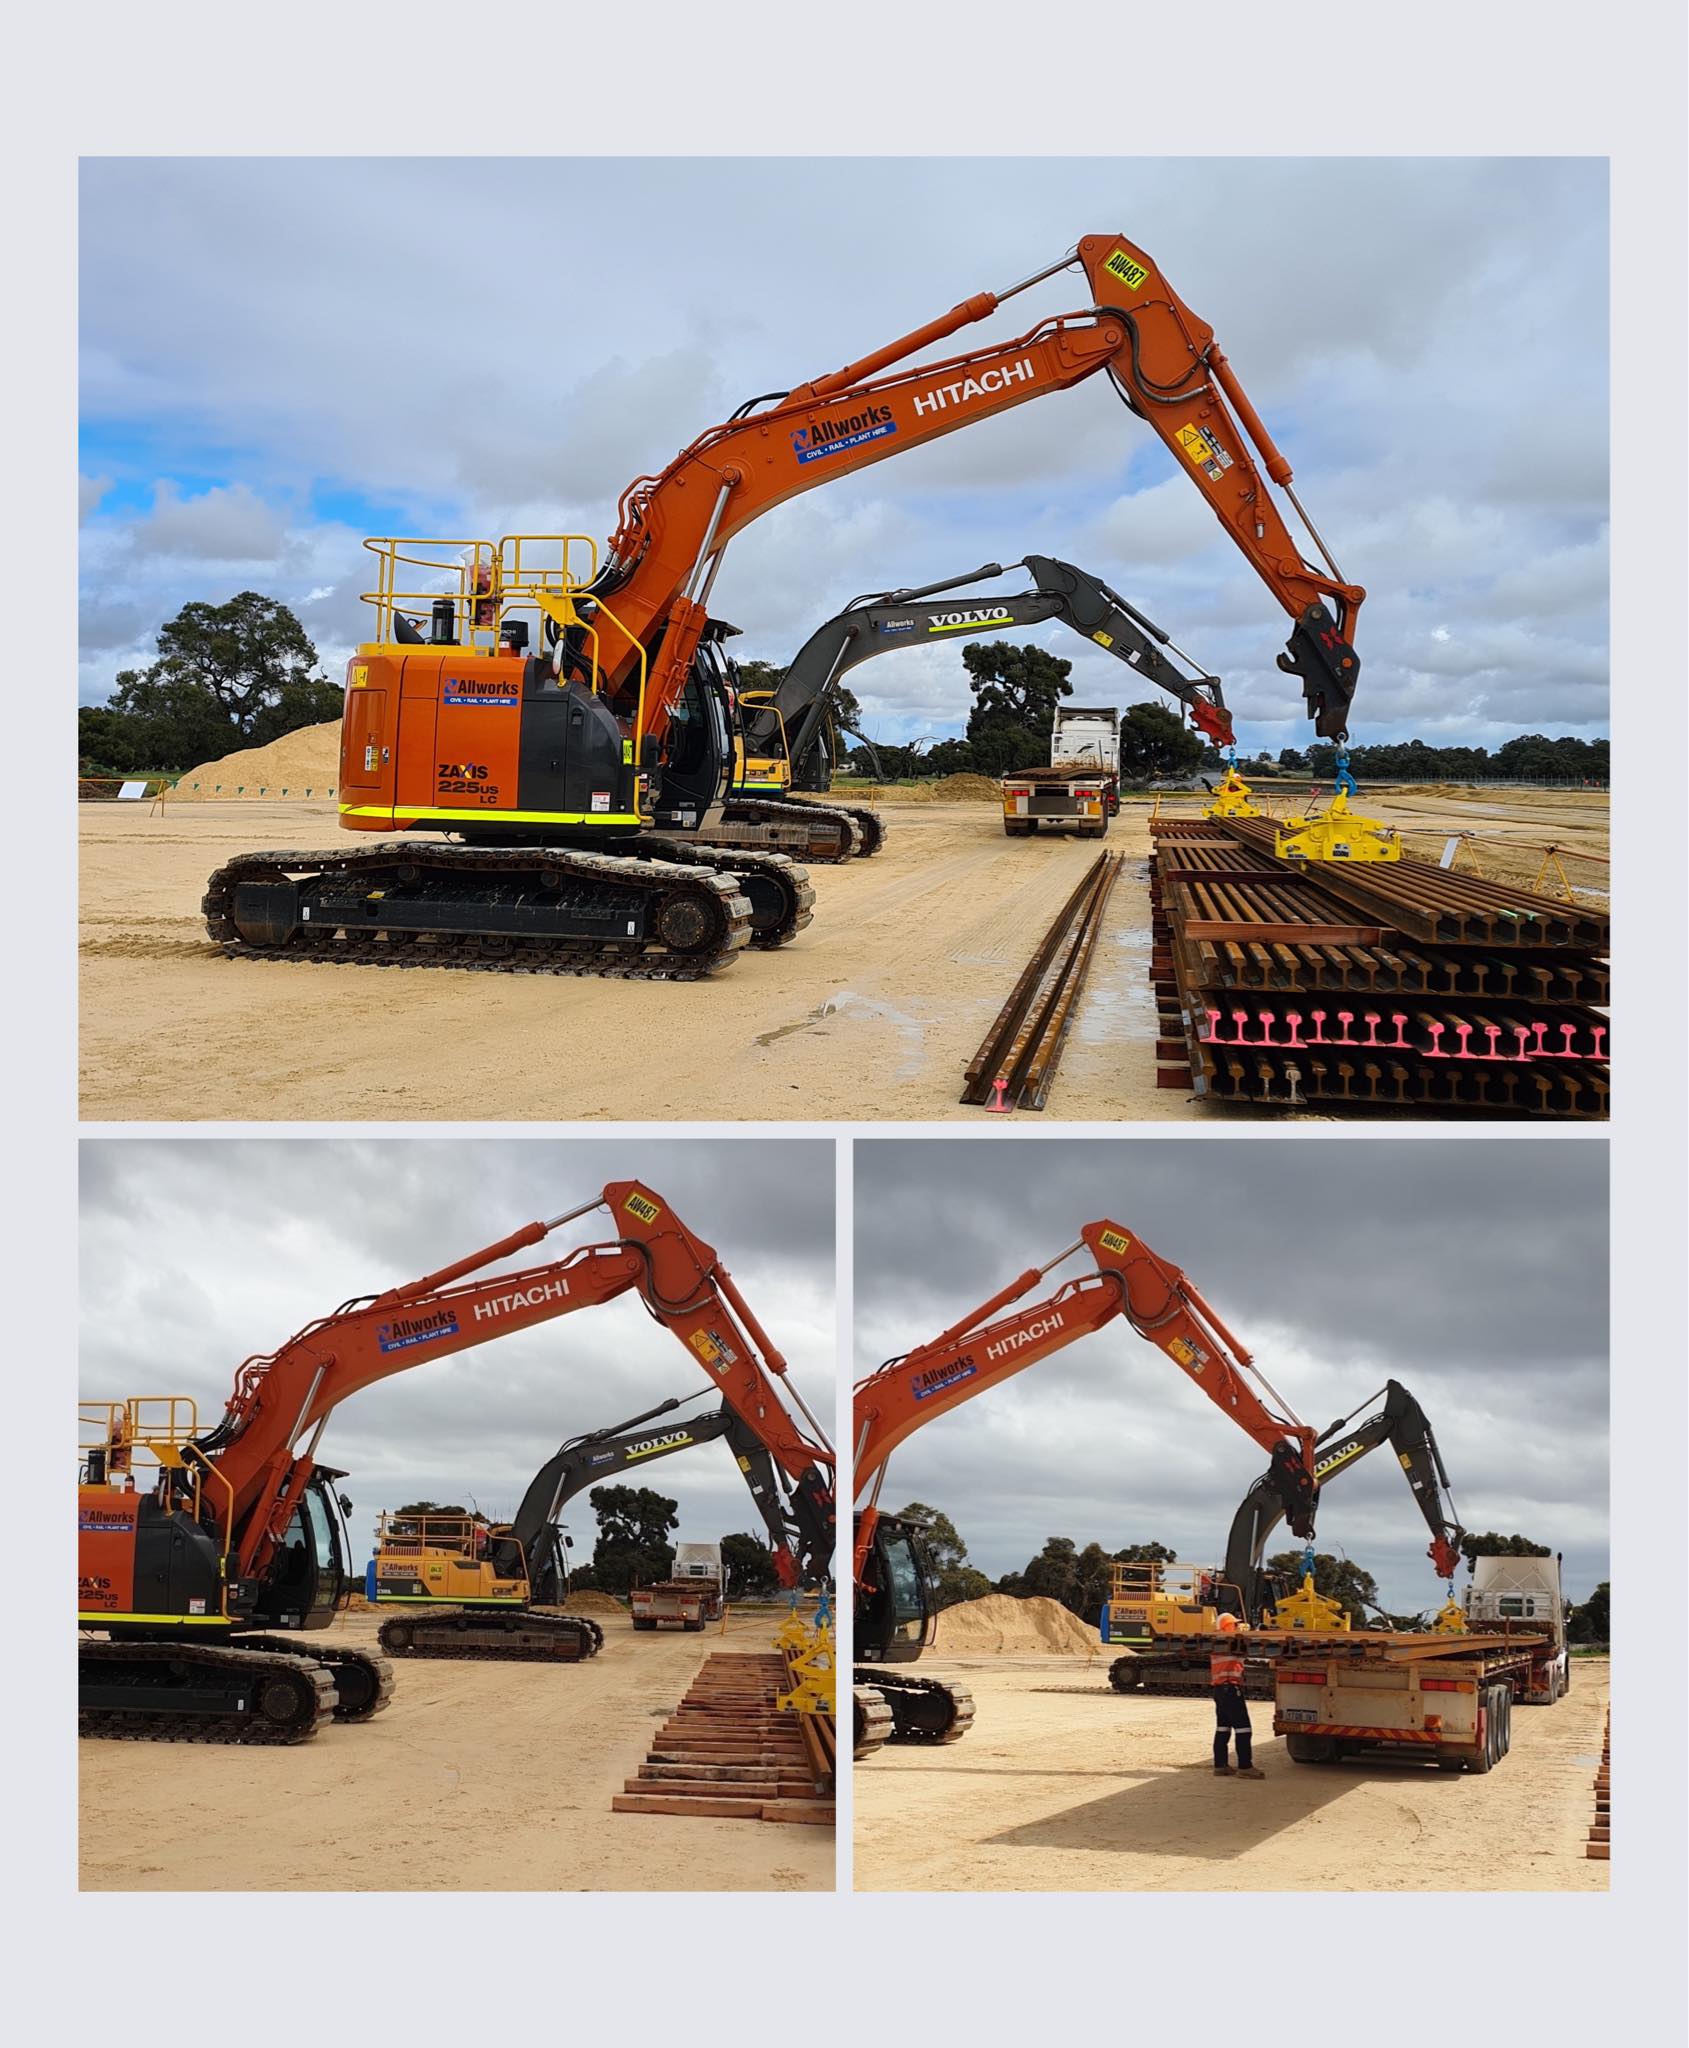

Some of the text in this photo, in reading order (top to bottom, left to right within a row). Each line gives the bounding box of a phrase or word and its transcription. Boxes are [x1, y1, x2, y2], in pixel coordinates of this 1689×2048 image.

[1108, 254, 1145, 285] AW487
[913, 359, 1034, 416] HITACHI
[811, 405, 892, 445] Allworks
[806, 426, 888, 459] CIVIL RAIL PLANT HIRE
[887, 619, 915, 628] Allworks
[928, 607, 1008, 627] VOLVO
[458, 680, 519, 695] Allworks
[438, 762, 488, 779] ZAXIS
[480, 796, 496, 804] LC
[628, 1196, 657, 1220] AW487
[473, 1279, 570, 1321] HITACHI
[393, 1310, 456, 1339] Allworks
[986, 1312, 1064, 1360] HITACHI
[387, 1326, 452, 1350] CIVIL RAIL PLANT HIRE
[922, 1355, 975, 1387] Allworks
[624, 1430, 688, 1455] VOLVO
[89, 1511, 135, 1523] Allworks
[390, 1563, 418, 1571] Allworks
